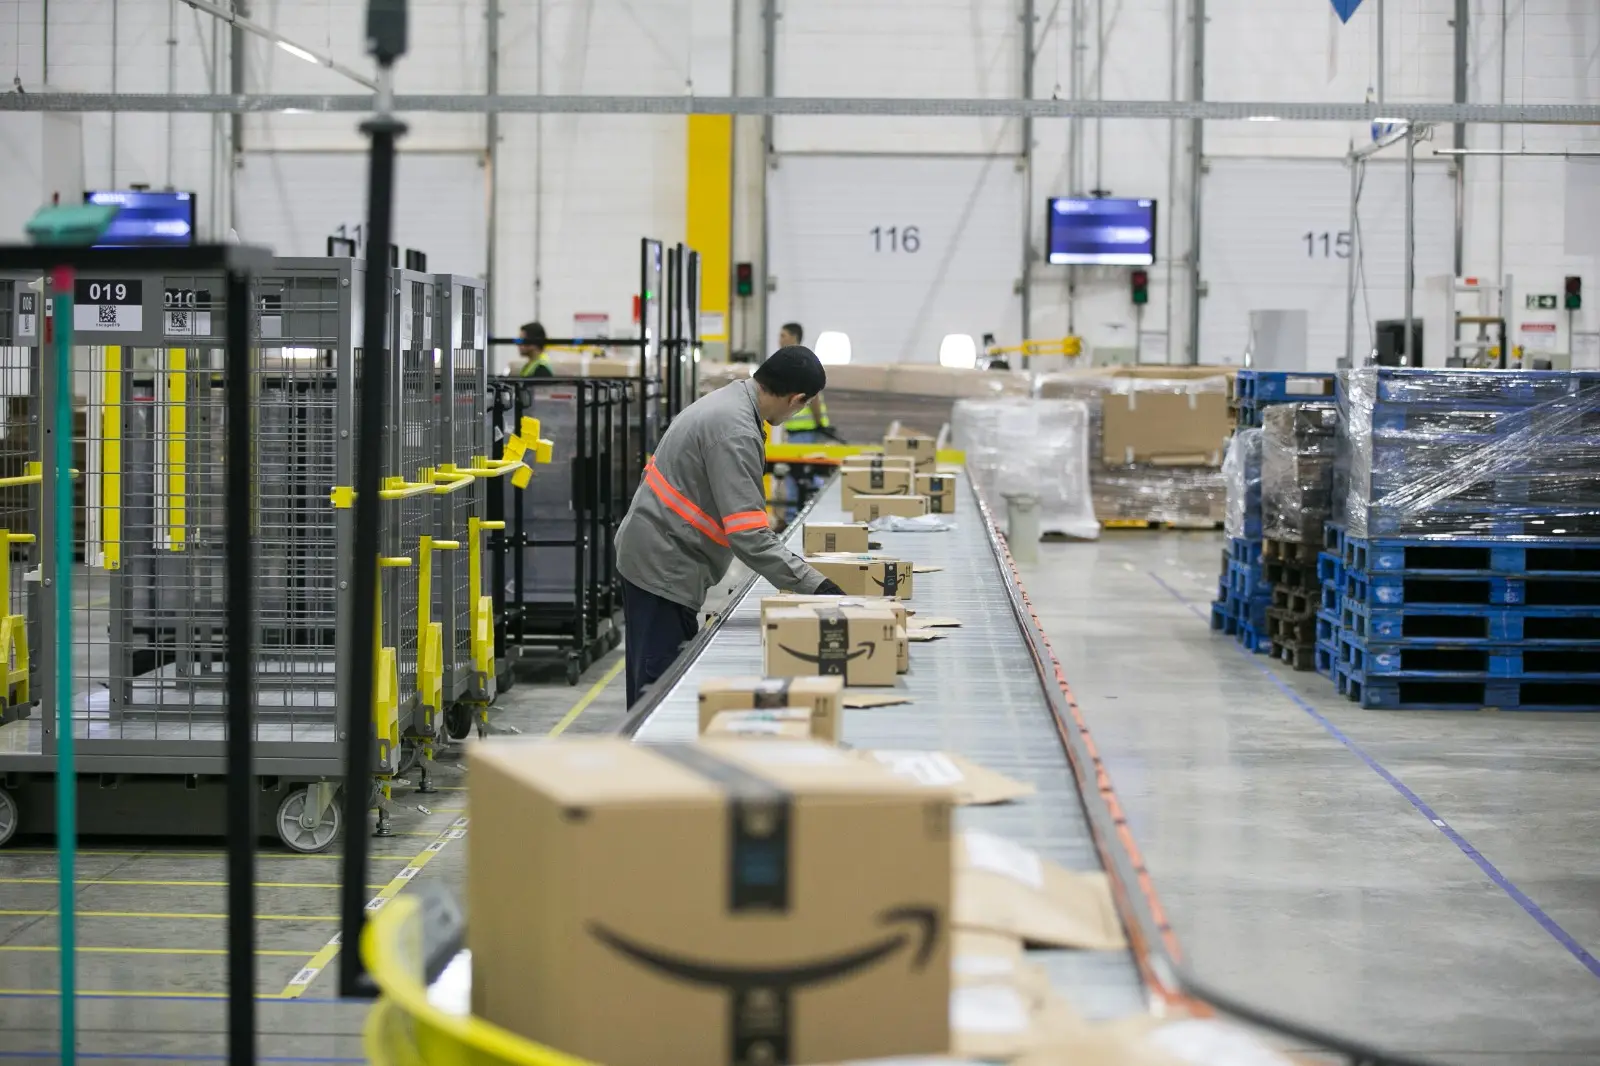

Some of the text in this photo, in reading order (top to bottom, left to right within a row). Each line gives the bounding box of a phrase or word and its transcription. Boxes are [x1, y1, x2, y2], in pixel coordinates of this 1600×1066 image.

[335, 224, 367, 250] 11
[870, 225, 921, 253] 116
[1302, 230, 1352, 258] 115
[89, 283, 127, 301] 019
[164, 291, 196, 308] 010
